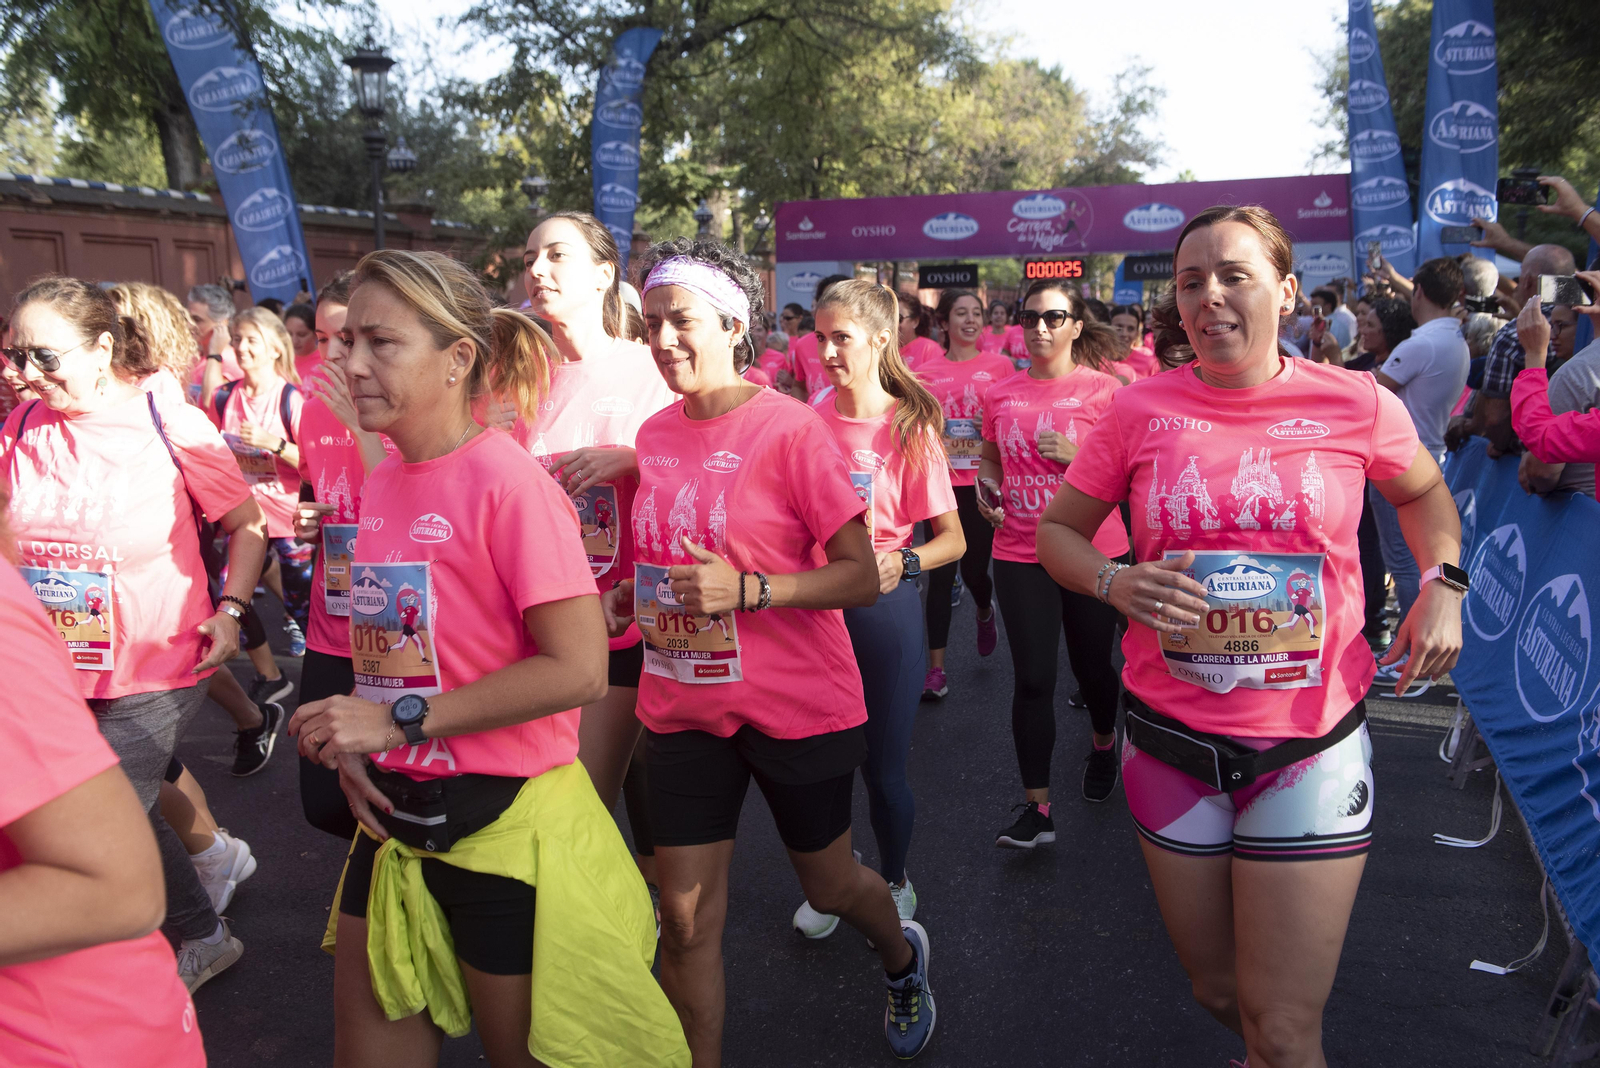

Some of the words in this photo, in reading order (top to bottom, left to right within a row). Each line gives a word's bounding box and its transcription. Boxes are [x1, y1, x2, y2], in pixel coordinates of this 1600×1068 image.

[1128, 213, 1181, 226] ASTURIANA
[1297, 208, 1348, 219] Santander
[851, 225, 896, 238] OYSHO
[927, 221, 975, 234] ASTURIANA
[785, 231, 827, 241] Santander
[1026, 260, 1083, 279] 000025
[927, 271, 971, 284] OYSHO
[1148, 416, 1212, 433] OYSHO
[1271, 427, 1326, 436] ASTURIANA
[320, 435, 354, 447] OYSHO
[641, 455, 679, 468] OYSHO
[1006, 475, 1020, 487] TU
[1024, 473, 1064, 486] DORS
[410, 523, 448, 539] ASTURIANA
[31, 541, 124, 562] DORSAL
[1207, 578, 1272, 592] ASTURIANA
[1470, 549, 1515, 626] ASTURIANA
[34, 586, 74, 598] ASTURIANA
[352, 590, 386, 607] ASTURIANA
[331, 602, 350, 610] OYSH
[658, 612, 697, 634] 016
[1206, 608, 1274, 634] 016
[354, 625, 388, 654] 016
[1541, 607, 1561, 637] CENTRAL
[1560, 628, 1584, 663] LECHERA
[666, 638, 689, 649] 2038
[1223, 640, 1260, 652] 4886
[672, 651, 680, 659] DE
[680, 651, 690, 659] LA
[690, 651, 712, 660] MUJER
[1191, 654, 1231, 664] CARRERA
[1234, 655, 1245, 664] DE
[1248, 655, 1259, 664] LA
[1261, 652, 1289, 663] MUJER
[1519, 603, 1577, 709] ASTURIANA
[362, 659, 380, 673] 5387
[1178, 667, 1224, 684] OYSHO
[1276, 670, 1302, 679] Santander
[367, 676, 374, 685] DE
[374, 676, 381, 686] LA
[382, 677, 405, 688] MUJER
